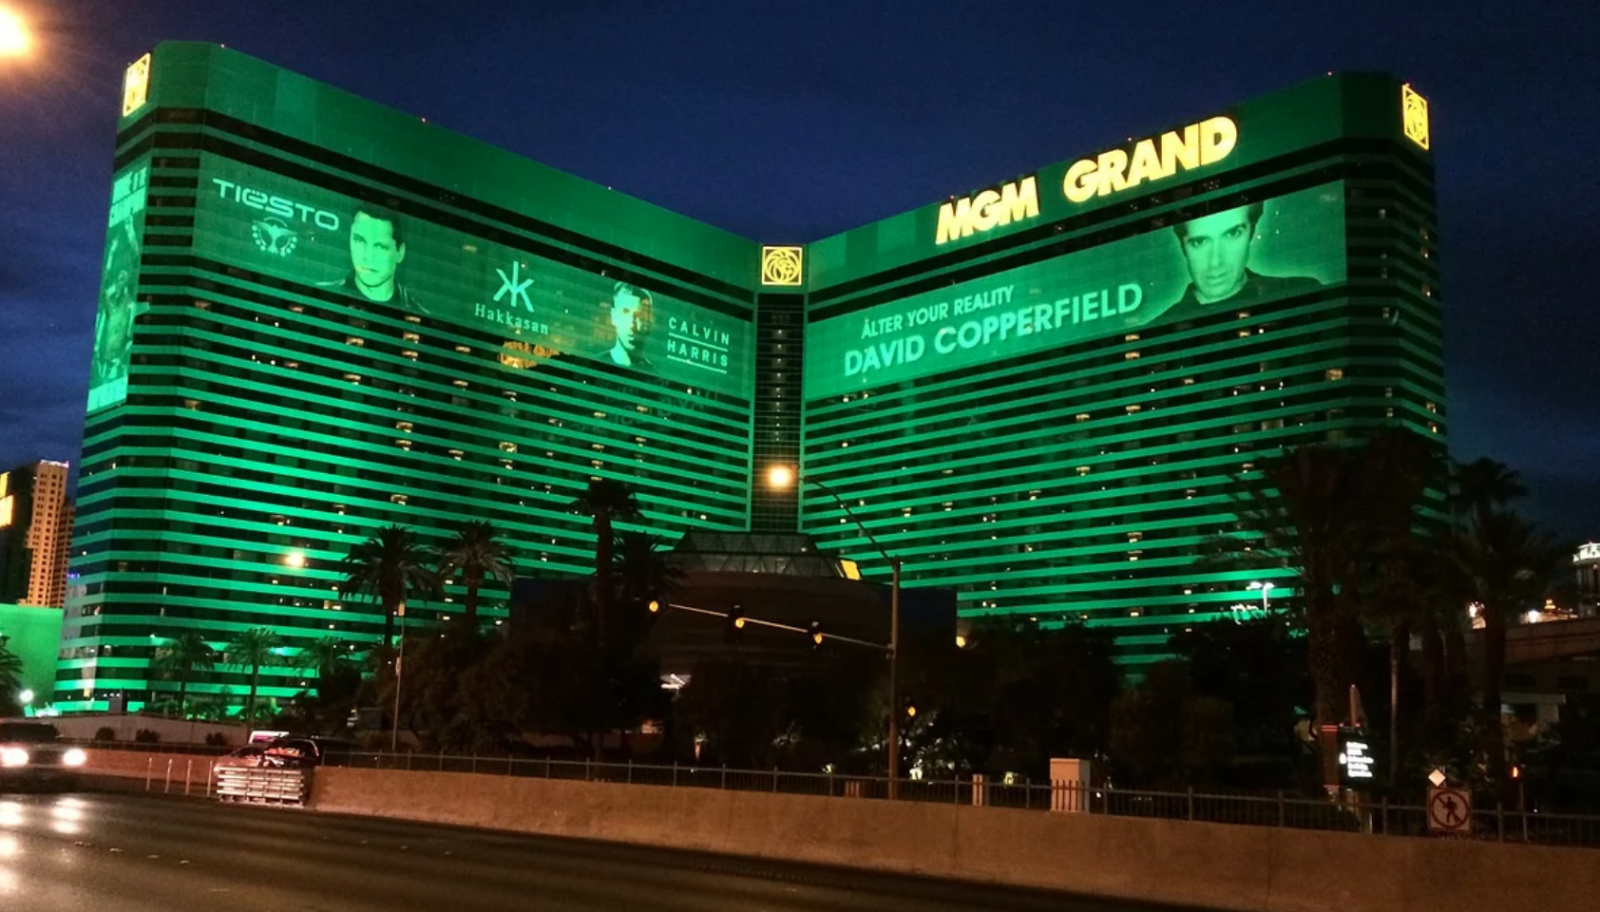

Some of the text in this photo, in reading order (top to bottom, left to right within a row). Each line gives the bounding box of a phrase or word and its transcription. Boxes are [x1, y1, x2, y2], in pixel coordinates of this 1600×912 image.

[936, 115, 1237, 246] MGM GRAND
[474, 303, 549, 335] Hakkasan
[668, 316, 729, 346] CALVIN
[844, 283, 1143, 377] DAVID COPPERFIELD
[861, 285, 1015, 340] ALTER YOUR REALITY
[667, 339, 728, 367] HARRIS
